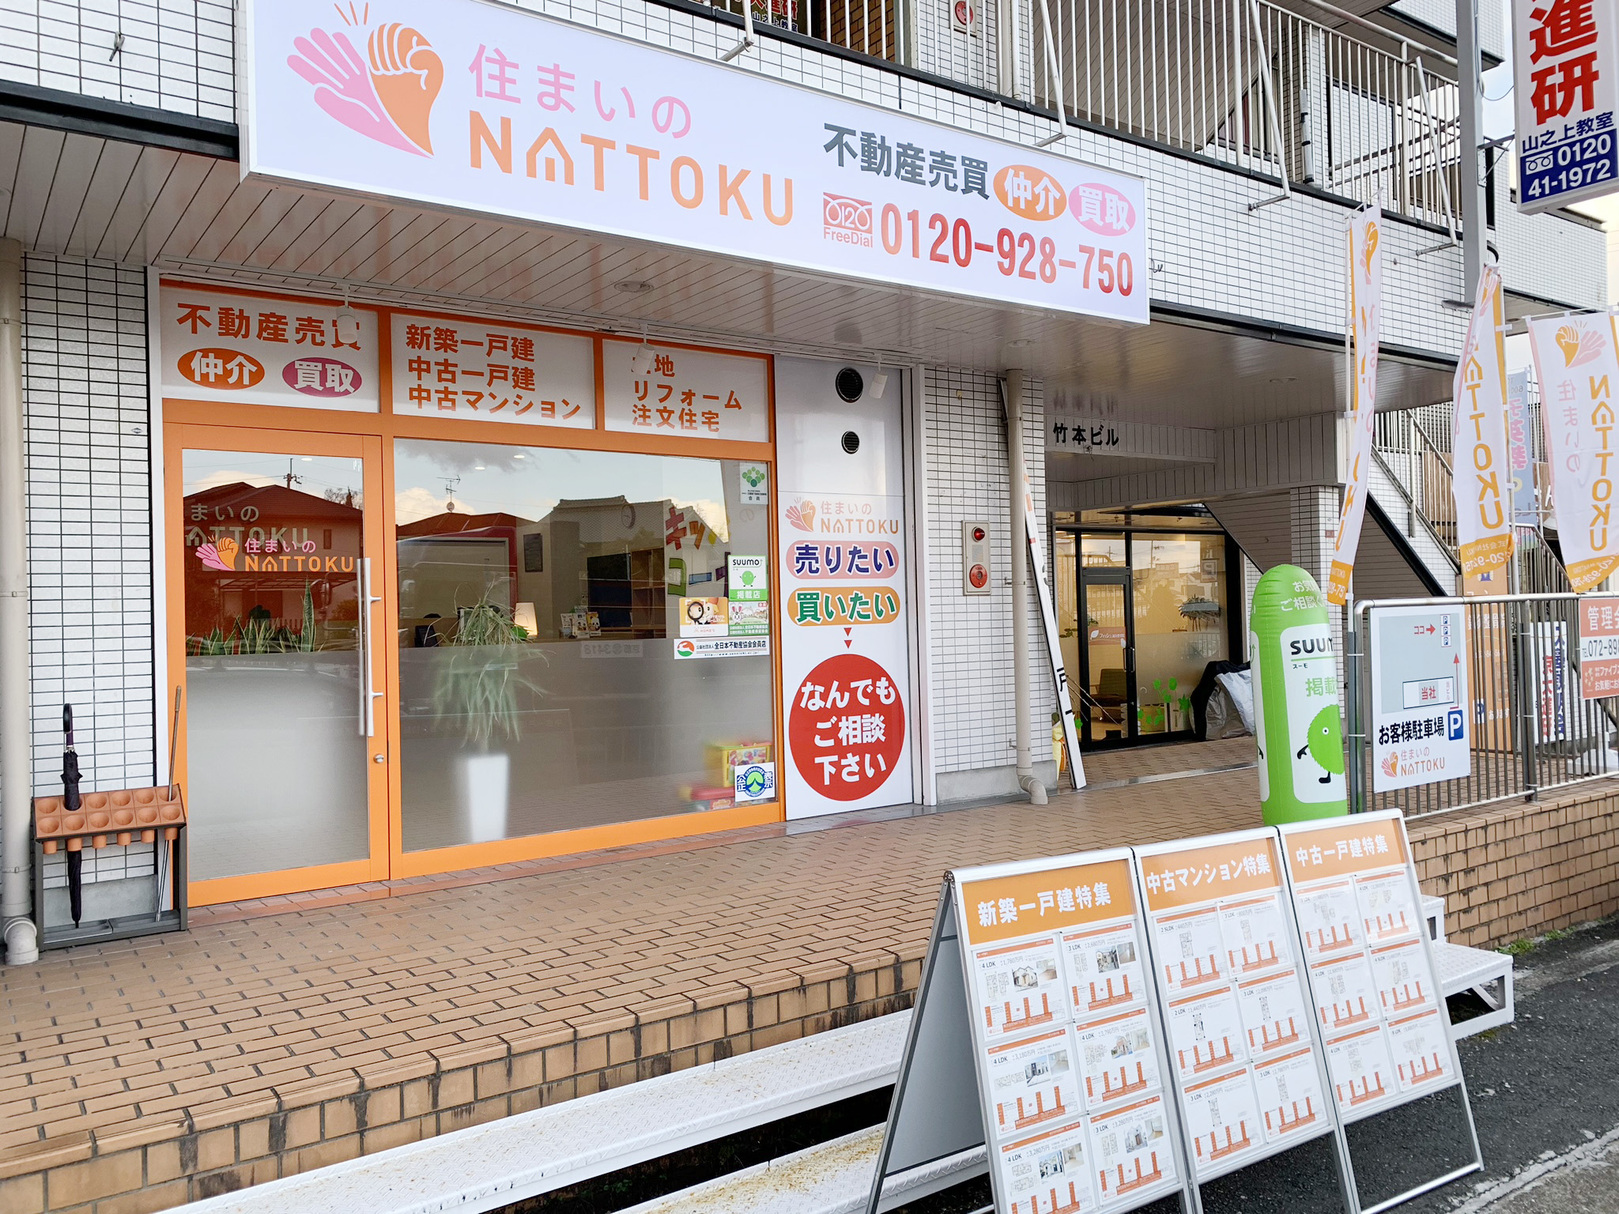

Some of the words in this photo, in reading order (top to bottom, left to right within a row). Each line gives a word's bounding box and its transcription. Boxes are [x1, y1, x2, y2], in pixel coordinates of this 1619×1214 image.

[469, 43, 692, 139] 住まいの
[1522, 111, 1614, 153] 山之上教室
[824, 123, 989, 200] 不動産売買
[1557, 134, 1612, 167] 0120
[470, 110, 793, 226] NATTOKU
[1528, 158, 1611, 197] 41-1972
[1004, 168, 1060, 221] 仲介
[1078, 186, 1130, 233] 買取
[824, 227, 873, 248] FreeDial
[881, 203, 1134, 297] 0120-928-750
[406, 324, 534, 362] 新築一戸建
[190, 351, 257, 385] 仲介
[294, 360, 353, 393] 買取
[408, 356, 536, 392] 中古一戸建
[631, 354, 676, 378] 地
[408, 384, 581, 420] 中古マンション
[634, 380, 743, 410] リフォーム
[632, 404, 720, 432] 注文住宅
[1053, 422, 1119, 446] 竹本ビル
[820, 500, 872, 515] 住まいの
[820, 518, 899, 535] NATTOKU
[245, 538, 317, 553] 住まいの
[796, 544, 894, 574] 売りたい
[245, 555, 354, 572] NATTOKU
[796, 590, 896, 622] 買いたい
[1588, 638, 1619, 657] 072-89
[799, 677, 896, 711] なんでも
[1421, 686, 1437, 700] 当社
[813, 713, 886, 748] ご相談
[1378, 716, 1445, 746] お客様駐車場
[814, 752, 887, 786] 下さい
[1401, 746, 1430, 761] 住まいの
[1401, 757, 1446, 776] NATTOKU
[1296, 834, 1389, 867] 中古一戸建特集
[1146, 853, 1271, 895] 中古マンション特集
[978, 882, 1112, 927] 新築一戸建特集
